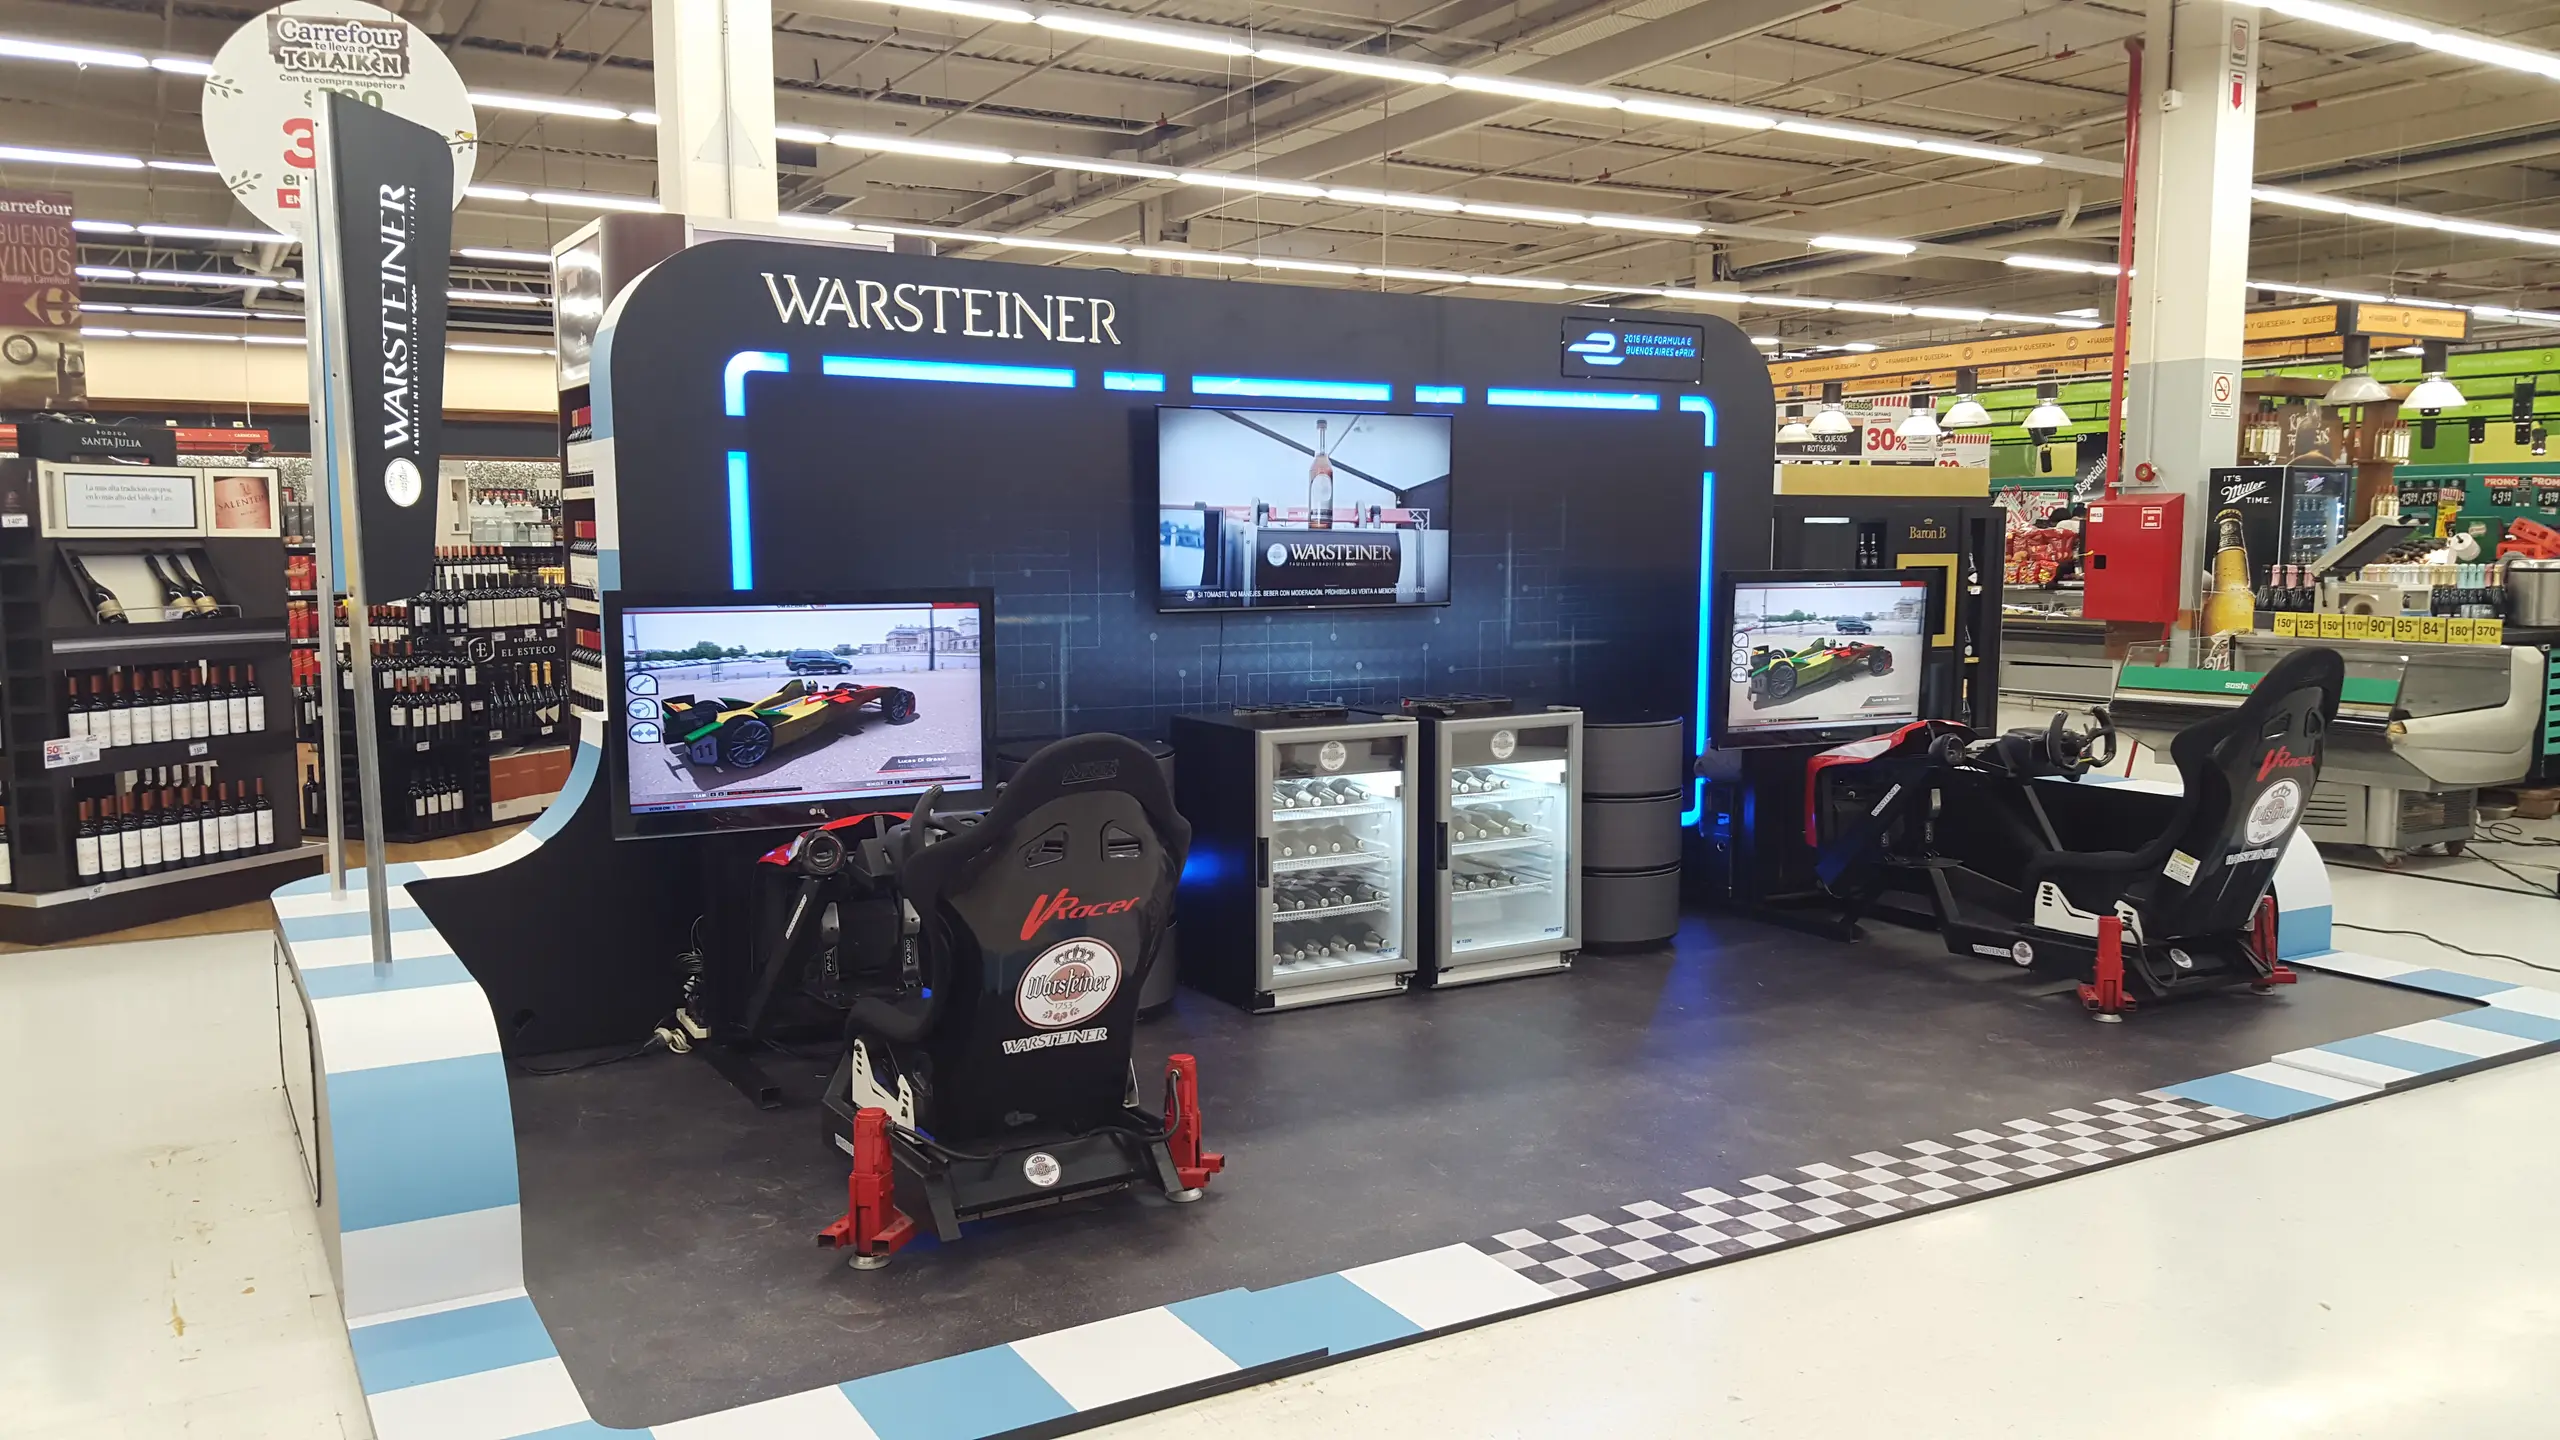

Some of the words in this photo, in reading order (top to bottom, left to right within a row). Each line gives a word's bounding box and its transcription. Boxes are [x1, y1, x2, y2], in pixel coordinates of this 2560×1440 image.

[279, 19, 400, 46] Carrefour
[315, 42, 326, 50] te
[329, 42, 356, 53] lleva
[279, 74, 300, 83] Con
[301, 75, 312, 83] tu
[314, 77, 353, 87] compra
[355, 79, 398, 89] superior
[0, 200, 73, 216] arrefour
[761, 272, 1121, 345] WARSTEINER
[380, 184, 409, 450] WARSTEINER
[1624, 334, 1640, 344] 2016
[1642, 335, 1653, 344] FIA
[1653, 336, 1685, 345] FORMULA
[1687, 337, 1692, 346] E
[2091, 336, 2114, 344] FIAMBR
[1625, 346, 1654, 355] BUENOS
[1654, 347, 1674, 356] AIRES
[1675, 348, 1696, 357] ePRIX
[81, 437, 114, 446] SANTA
[114, 437, 142, 448] JULIA
[1824, 435, 1847, 443] QUESOS
[1807, 444, 1837, 452] ROTISERÍA
[2484, 478, 2519, 486] PROMO
[2532, 477, 2560, 486] PROM
[2220, 480, 2266, 504] Miller
[2246, 496, 2272, 504] TIME.
[1909, 526, 1937, 539] Baron
[1939, 526, 1946, 539] B
[1290, 543, 1392, 560] WARSTEINER
[1204, 590, 1229, 598] TOMASTE,
[1238, 589, 1262, 597] MANEJES.
[1263, 589, 1279, 597] BEBER
[1280, 588, 1290, 596] CON
[1291, 588, 1324, 596] MODERACIÓN.
[501, 648, 513, 657] EL
[517, 645, 556, 656] ESTECO
[696, 743, 713, 759] 11
[1026, 968, 1112, 999] Warsteiner
[1055, 1002, 1072, 1010] 1753
[1003, 1028, 1108, 1053] WARSTEINER
